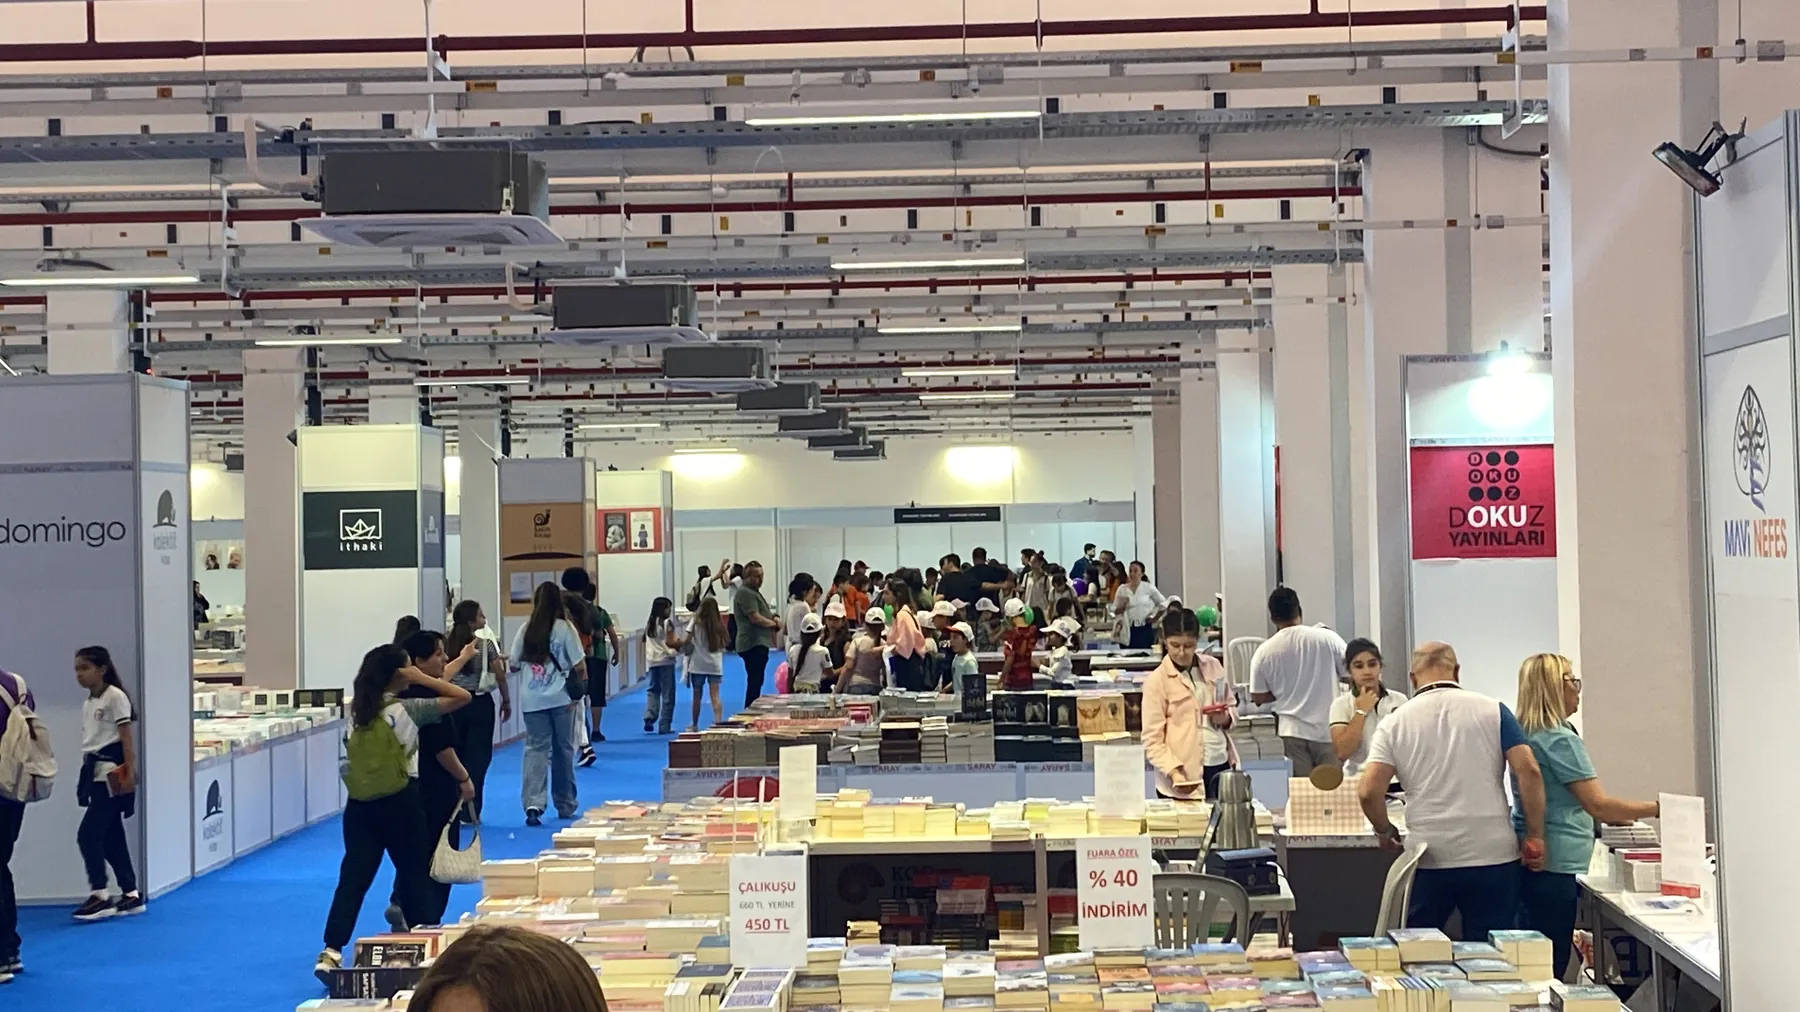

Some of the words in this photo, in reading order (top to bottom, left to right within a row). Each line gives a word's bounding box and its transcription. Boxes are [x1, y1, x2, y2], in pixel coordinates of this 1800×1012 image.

[1449, 504, 1545, 528] DOKUZ
[0, 515, 126, 547] domingo
[1449, 530, 1545, 546] YAYINLARI
[1754, 518, 1788, 559] NEFES
[340, 542, 383, 551] ithaki
[1087, 849, 1116, 858] FUARA
[1118, 848, 1139, 858] ÖZEL
[1089, 870, 1107, 888] %
[1113, 869, 1138, 887] 40
[738, 881, 796, 895] ÇALIKUŞU
[739, 901, 754, 909] 660
[756, 901, 764, 909] TL
[768, 900, 795, 909] YERİNE
[1082, 901, 1148, 918] İNDİRİM
[745, 919, 771, 931] 450
[774, 918, 790, 930] TL
